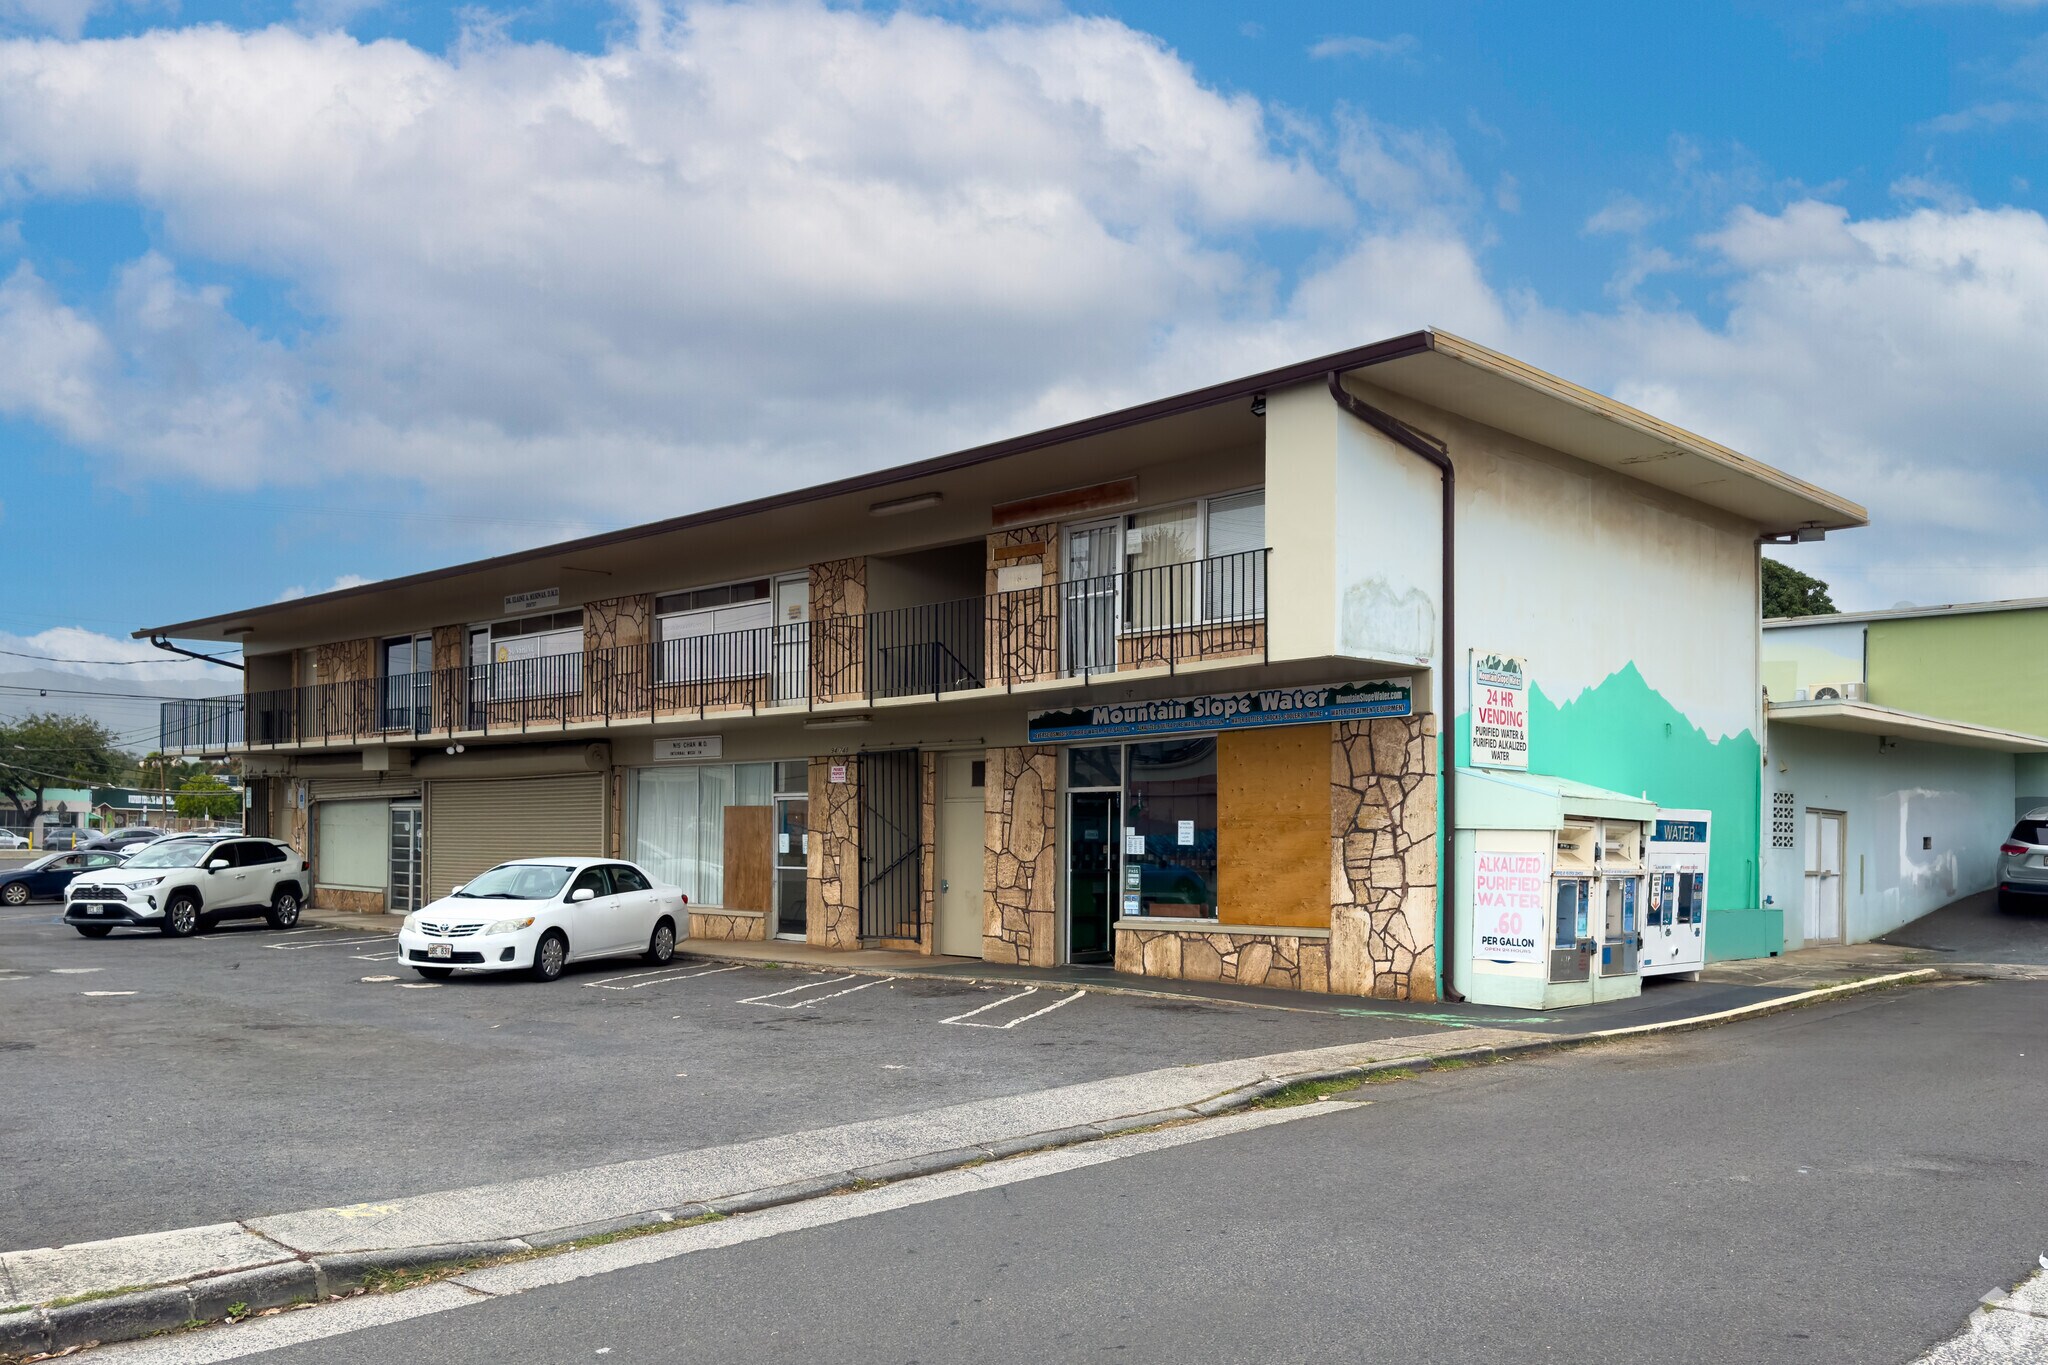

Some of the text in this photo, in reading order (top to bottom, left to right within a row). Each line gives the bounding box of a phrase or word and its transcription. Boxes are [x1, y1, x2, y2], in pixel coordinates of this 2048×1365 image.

[1335, 691, 1402, 705] MountainSlopeWater.com
[1487, 689, 1514, 708] 24 HR
[1092, 690, 1329, 725] Mountain Slope Water
[1377, 704, 1406, 713] EQUIPMENT
[1478, 707, 1523, 728] VENDING
[1475, 726, 1524, 741] PURIFIED WATER &
[1473, 737, 1527, 752] PURIFIED ALKALIZED
[1491, 750, 1510, 761] WATER
[1664, 825, 1696, 841] WATER
[1478, 857, 1541, 874] ALKALIZED
[1477, 875, 1542, 892] PURIFIED
[1477, 892, 1541, 908] WATER
[1493, 912, 1523, 935] .60
[1481, 936, 1535, 948] PER GALLON
